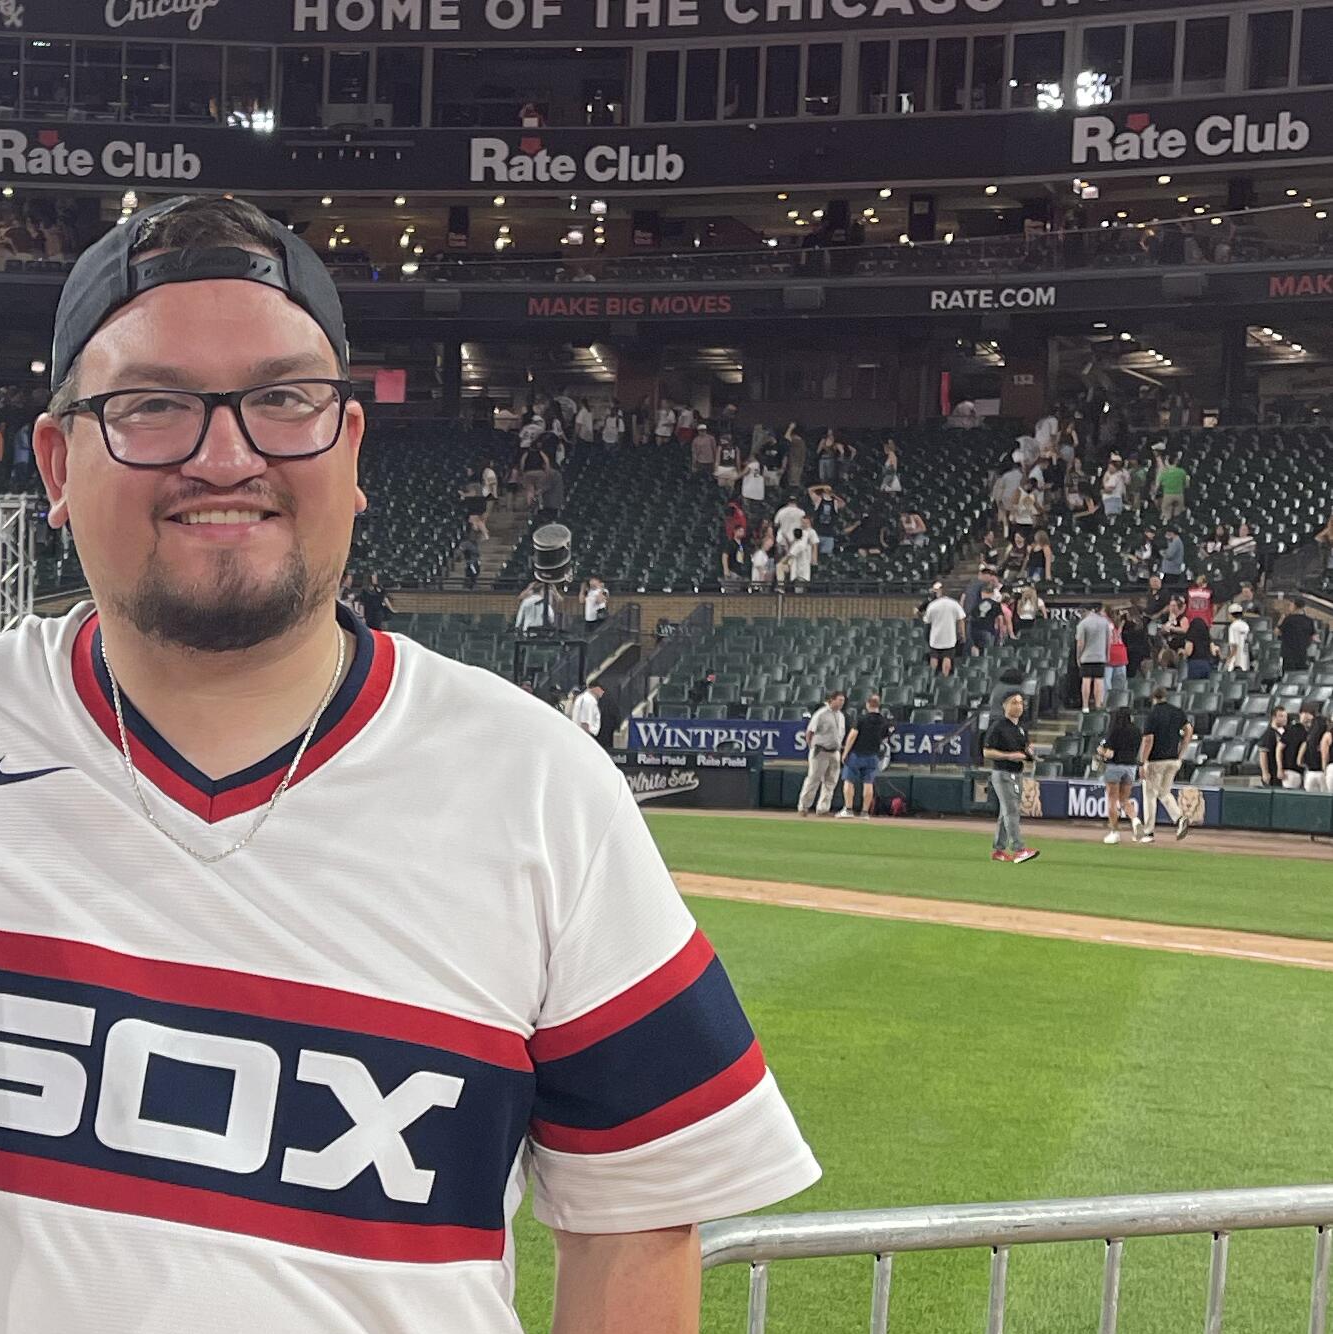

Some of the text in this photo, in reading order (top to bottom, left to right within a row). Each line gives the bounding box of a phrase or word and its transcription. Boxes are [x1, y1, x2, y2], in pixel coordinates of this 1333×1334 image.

[293, 0, 461, 31] HOME
[484, 0, 562, 30] OF
[592, 0, 700, 28] THE
[1072, 112, 1310, 163] Rate Club
[101, 140, 202, 180] Club
[470, 138, 685, 182] Rate Club
[930, 286, 1056, 310] RATE.COM
[1269, 273, 1333, 297] MAK
[528, 296, 732, 316] MAKE BIG MOVES
[635, 722, 780, 750] WINTRUST
[890, 733, 962, 755] SEATS
